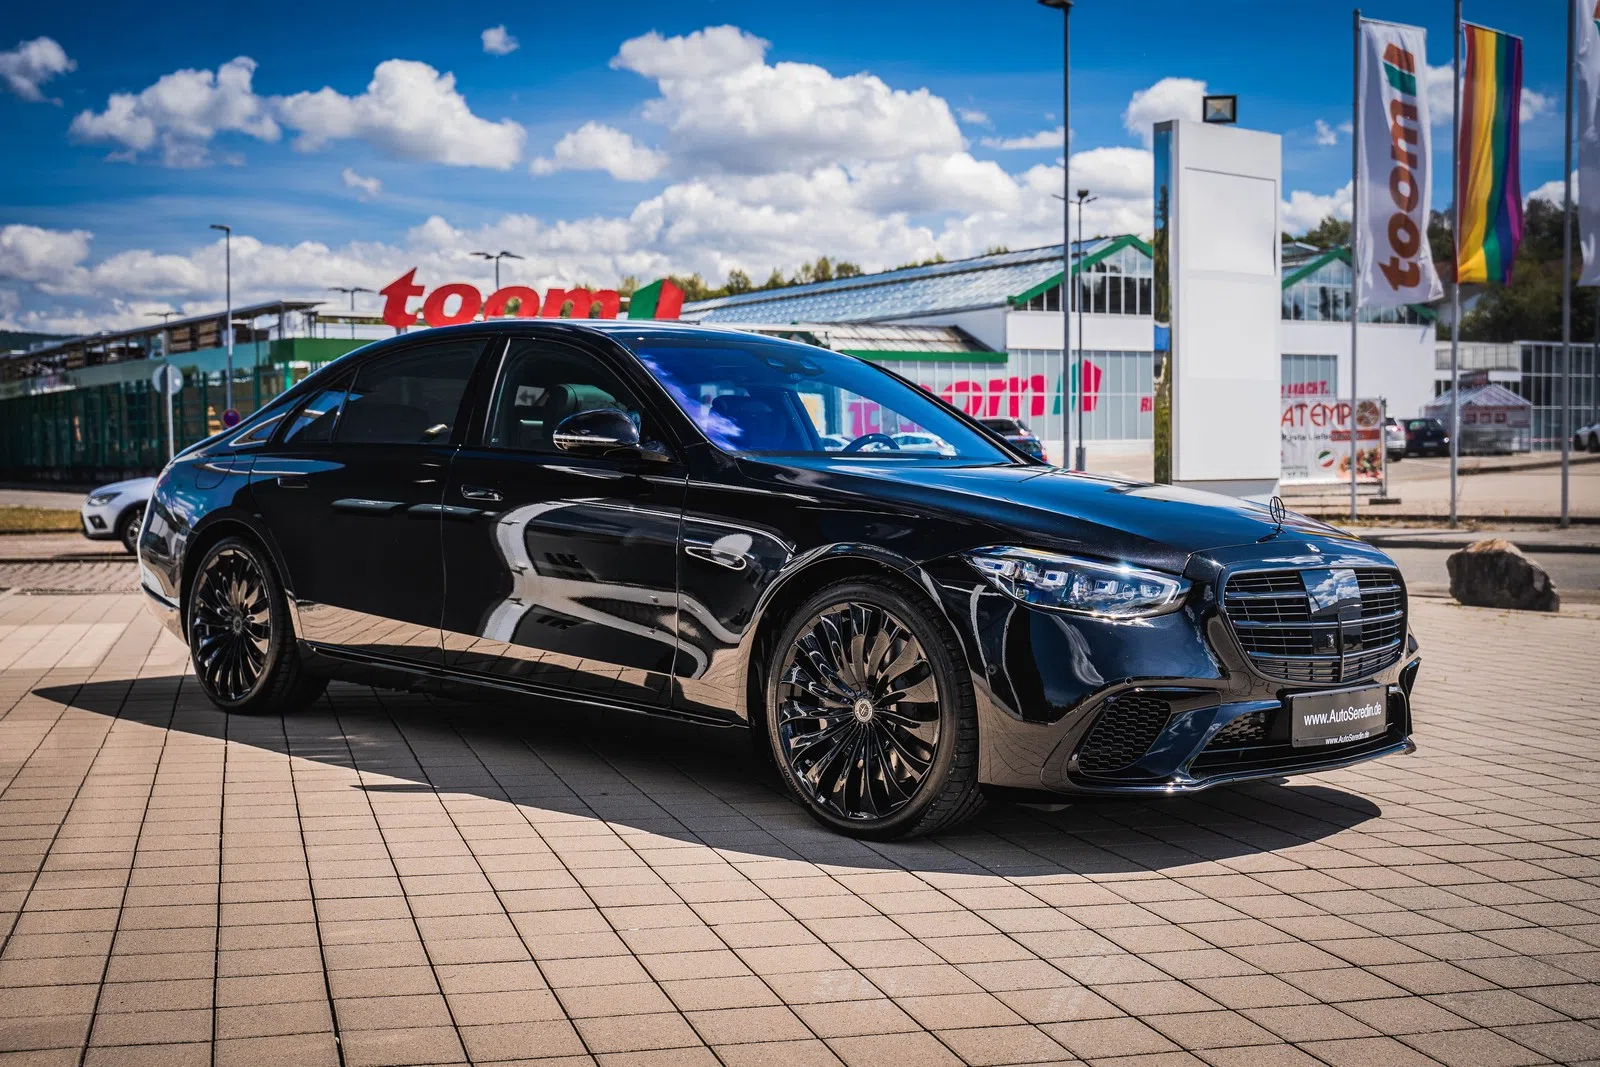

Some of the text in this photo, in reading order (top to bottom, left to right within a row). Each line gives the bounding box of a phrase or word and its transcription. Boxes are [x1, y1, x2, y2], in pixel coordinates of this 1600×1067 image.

[1378, 98, 1421, 291] toom
[379, 266, 621, 328] toom
[1303, 702, 1382, 726] www.AutoSeredin.de
